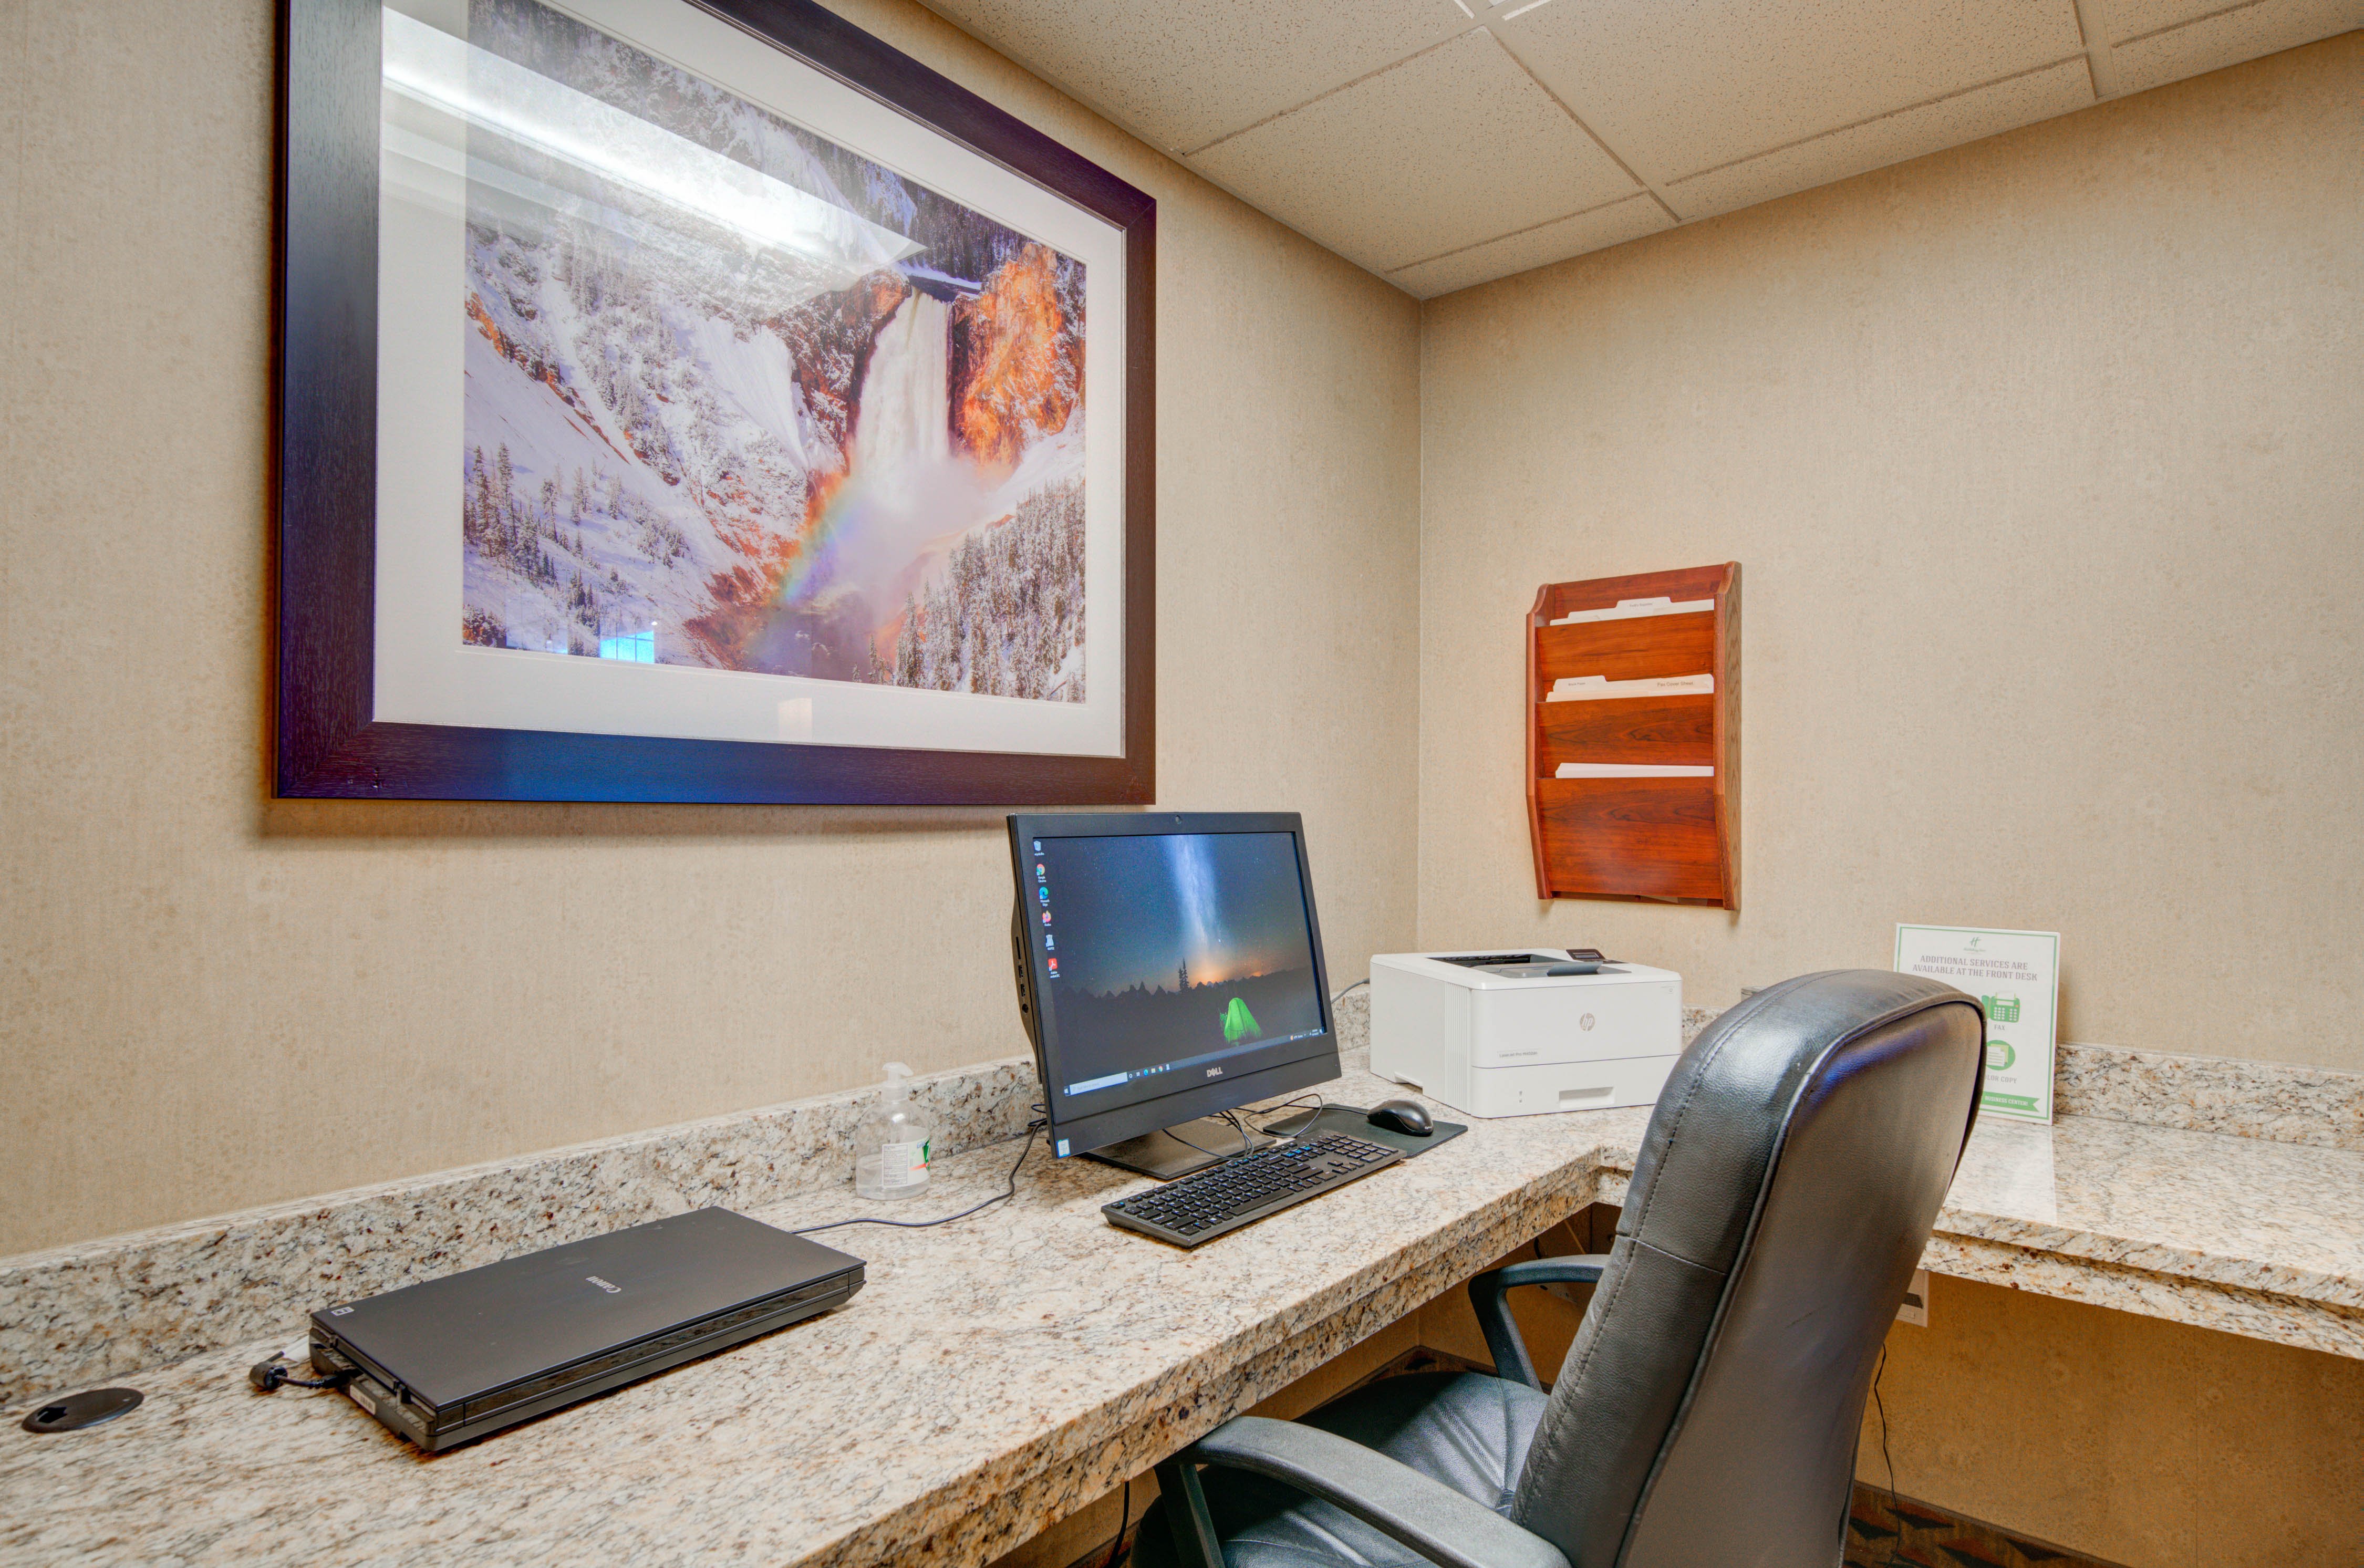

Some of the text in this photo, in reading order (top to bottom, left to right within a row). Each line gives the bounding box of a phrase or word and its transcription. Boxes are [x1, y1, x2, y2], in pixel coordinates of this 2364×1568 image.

[1920, 955, 2028, 970] ADDITIONAL SERVICES ARE
[1912, 964, 1955, 974] AVAILABLE
[1967, 968, 1984, 977] THE
[1986, 970, 2013, 979] FRONT
[2015, 972, 2038, 981] DESK
[1206, 1066, 1223, 1078] DELL
[585, 1275, 621, 1293] Canon
